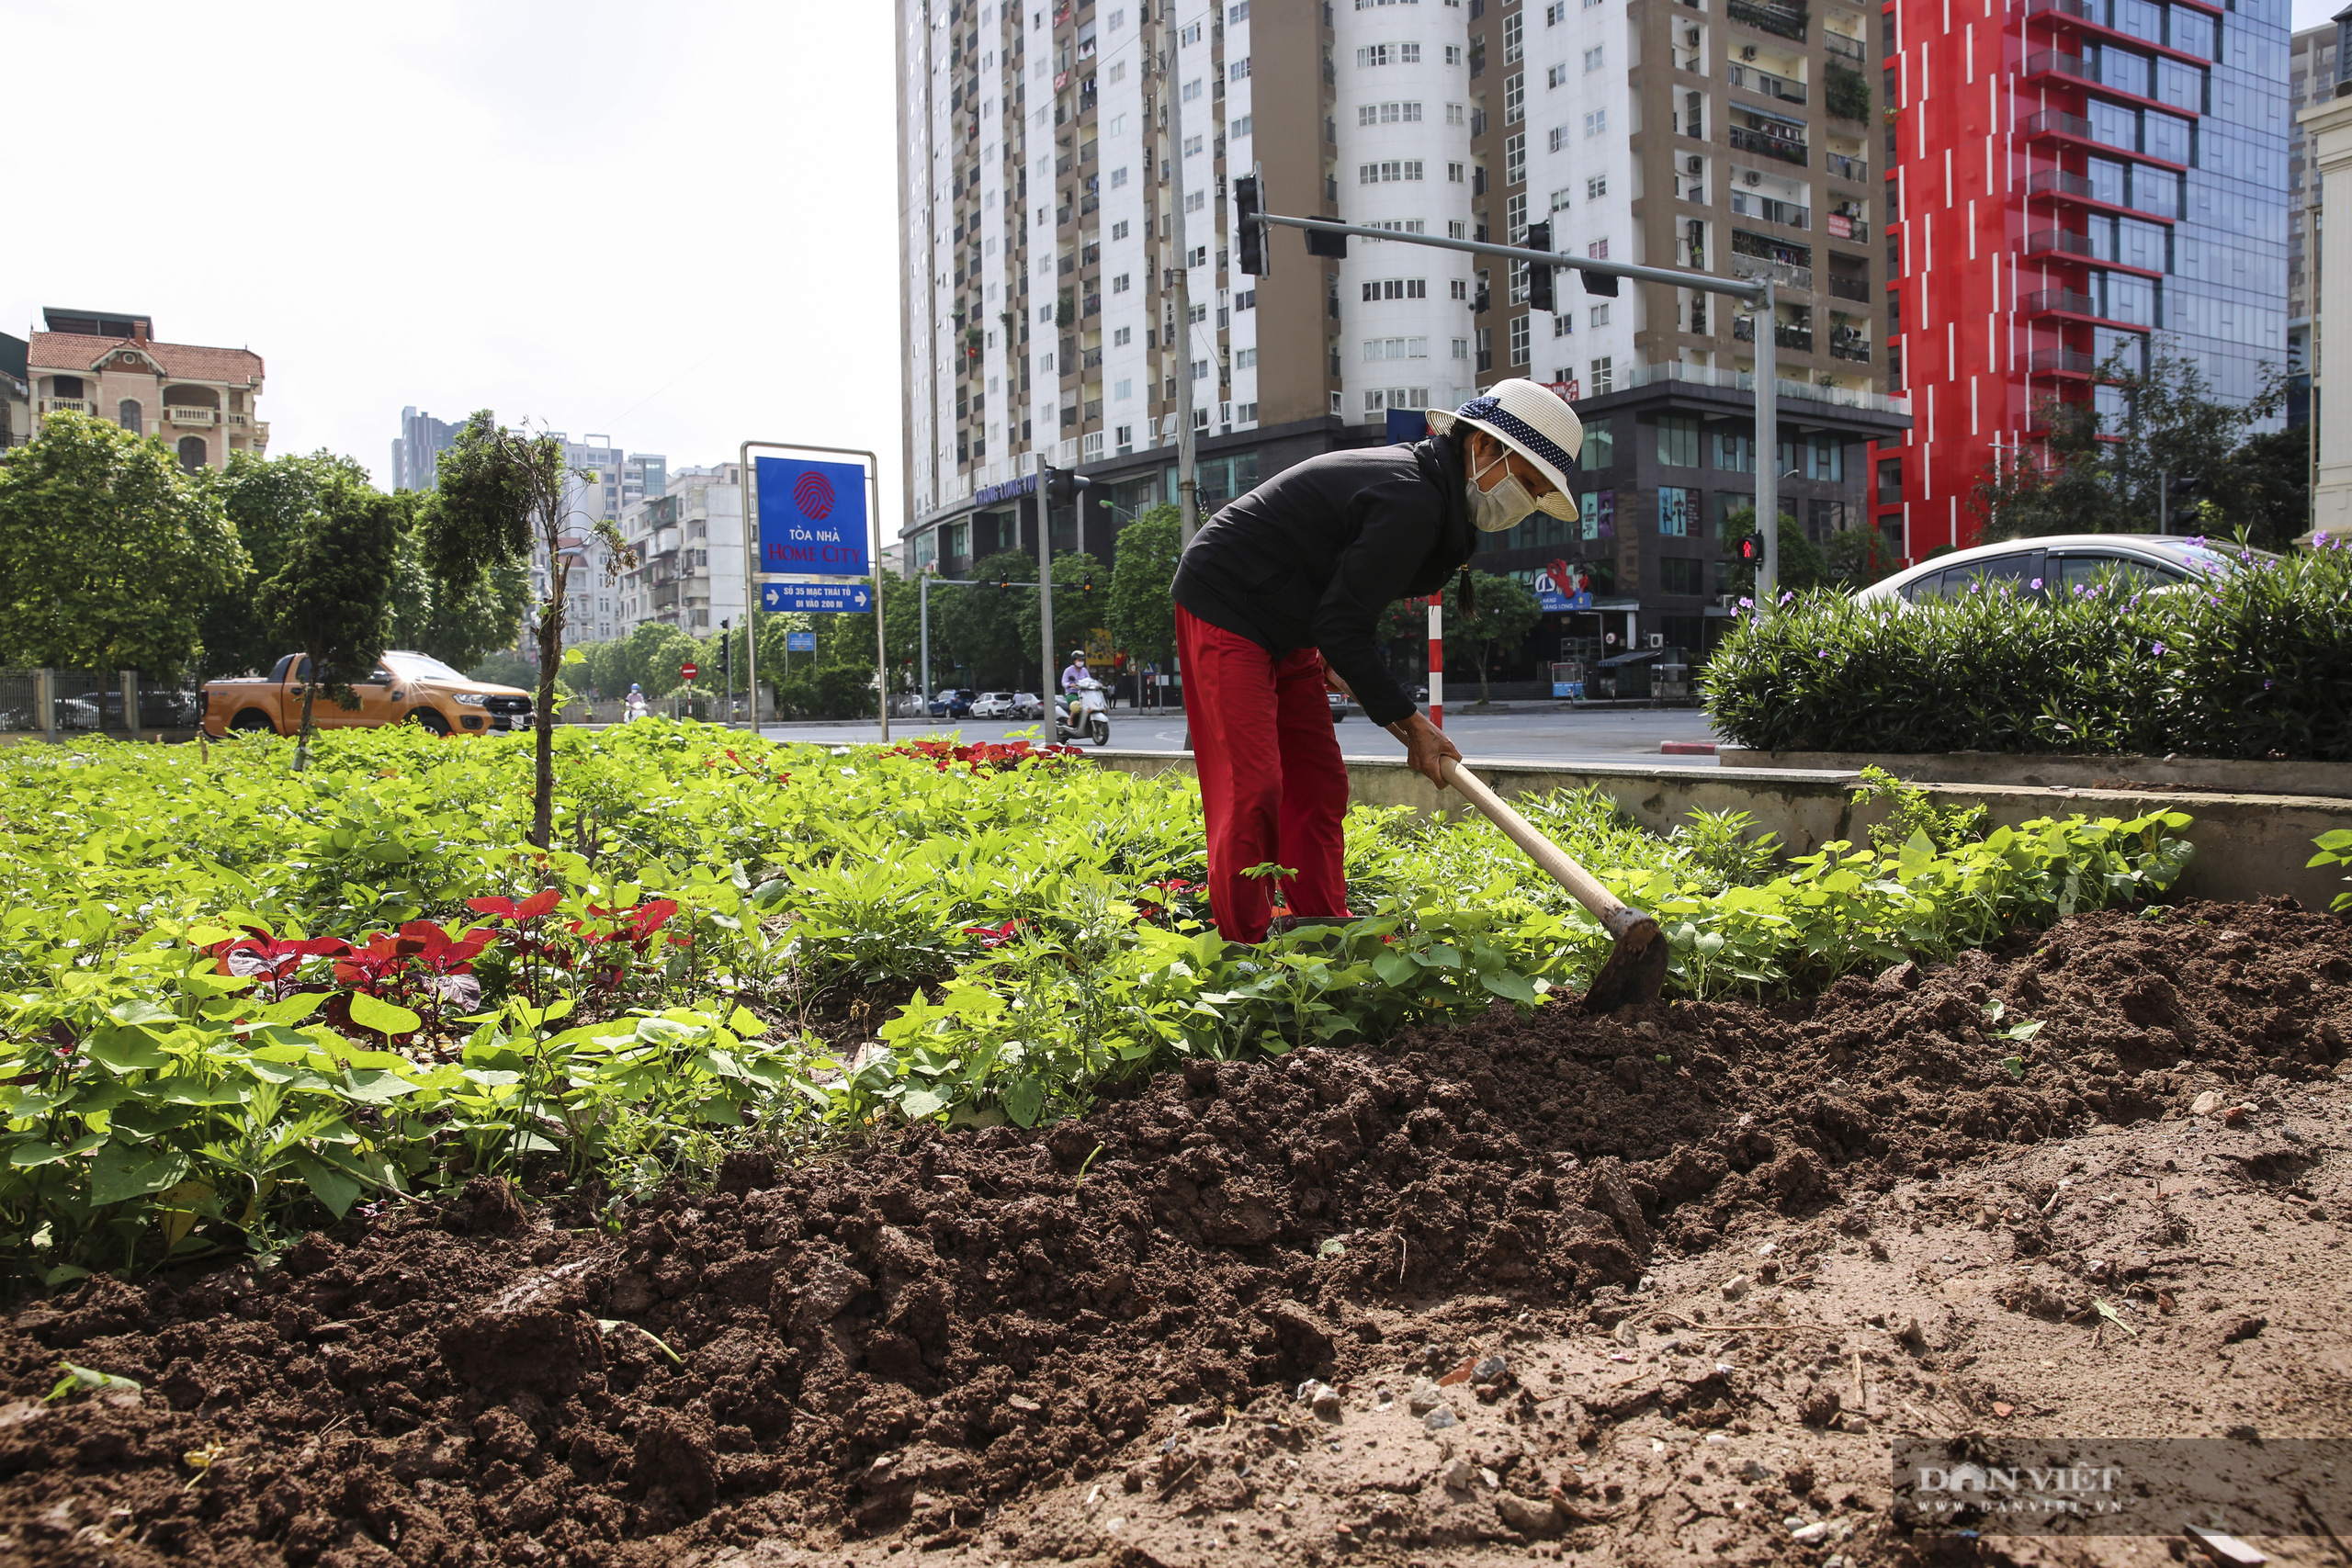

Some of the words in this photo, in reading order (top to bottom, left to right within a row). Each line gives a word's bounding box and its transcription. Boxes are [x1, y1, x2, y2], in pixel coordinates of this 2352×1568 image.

[1000, 478, 1022, 499] LONG
[789, 525, 812, 541] TÒA
[817, 527, 841, 542] NHÀ
[768, 543, 816, 561] HOME
[822, 546, 861, 563] CITY
[784, 585, 793, 595] SỐ
[806, 588, 822, 597] MẠC
[824, 586, 840, 595] THÁI
[806, 598, 819, 608] VÀO
